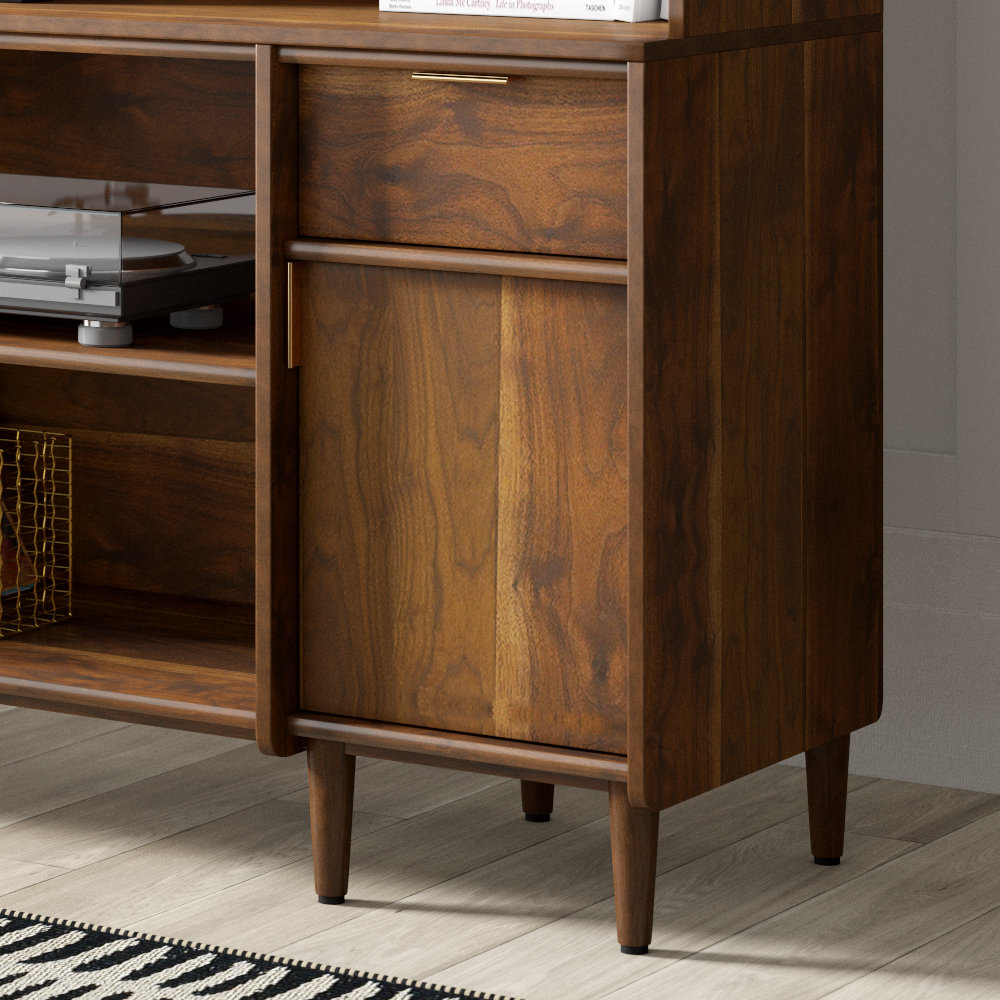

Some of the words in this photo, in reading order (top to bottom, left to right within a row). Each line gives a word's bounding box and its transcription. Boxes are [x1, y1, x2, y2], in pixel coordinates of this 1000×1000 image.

[508, 0, 515, 9] in
[516, 0, 554, 14] Photographs
[585, 3, 606, 12] TASCHEN
